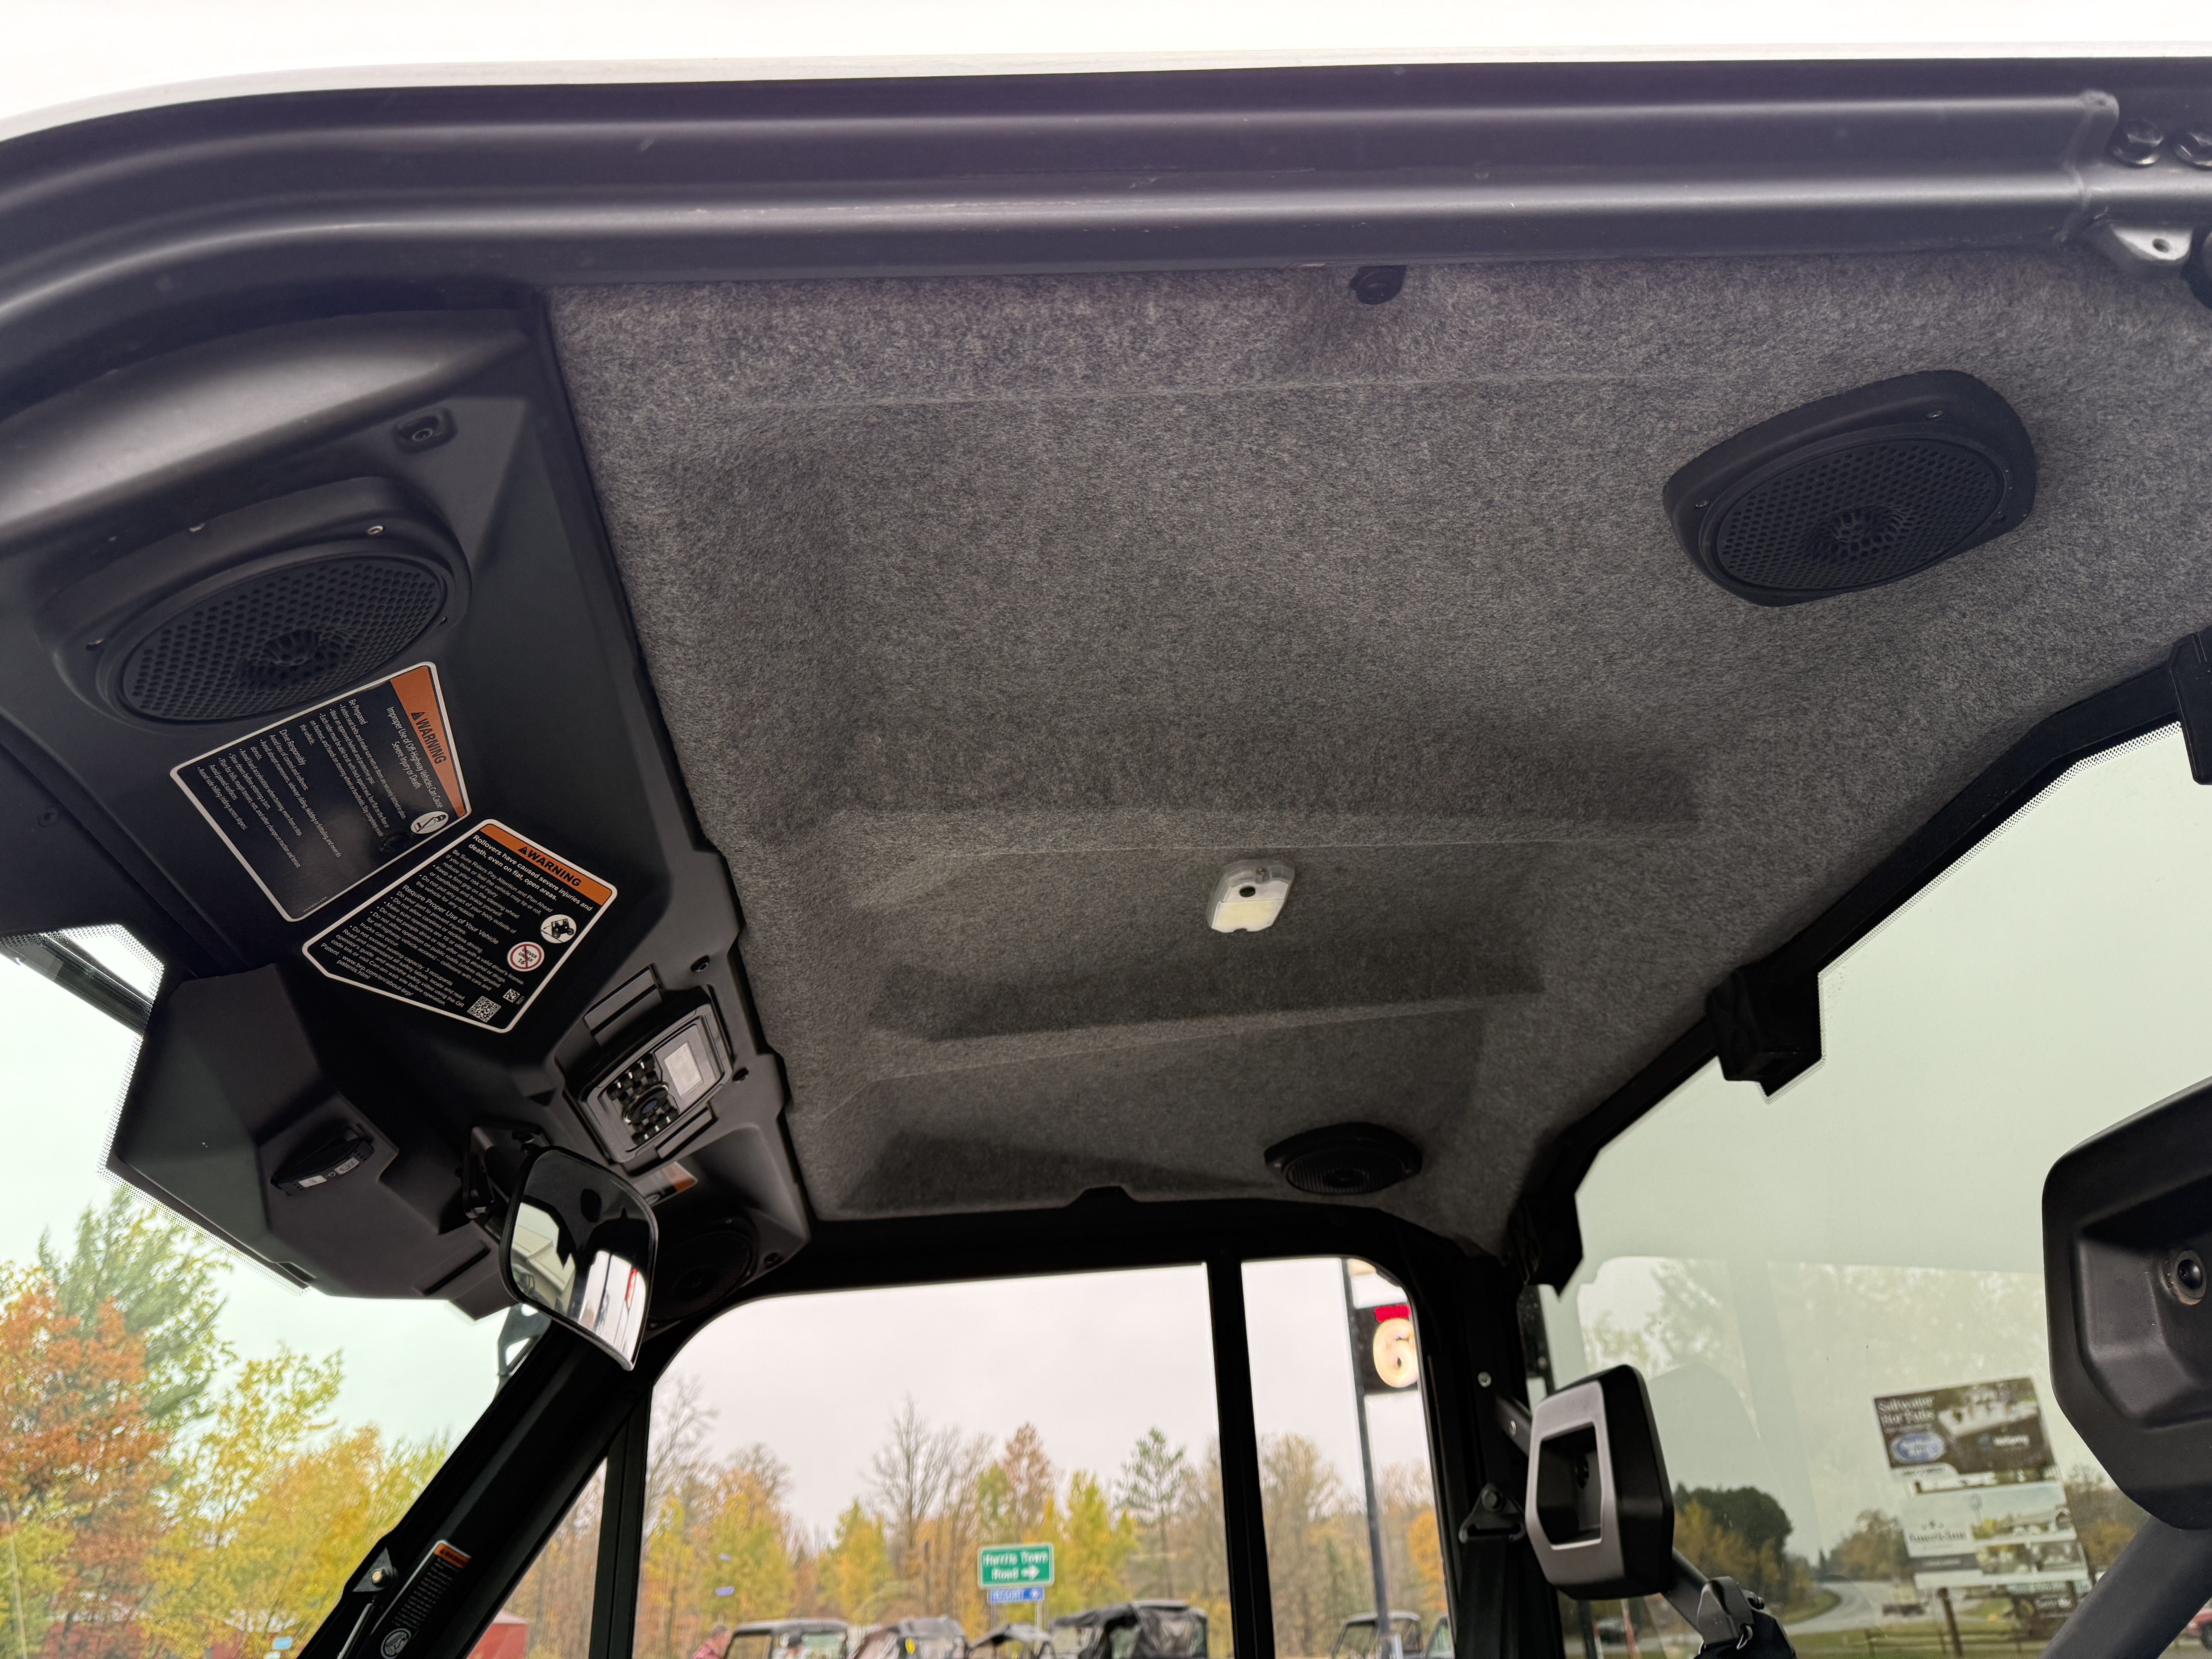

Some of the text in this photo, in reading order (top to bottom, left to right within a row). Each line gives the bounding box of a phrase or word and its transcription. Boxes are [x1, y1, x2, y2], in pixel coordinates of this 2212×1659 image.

[352, 704, 368, 725] Prepared
[386, 706, 403, 730] Improper
[398, 728, 407, 739] Use
[416, 718, 447, 764] WARNING
[279, 729, 307, 766] Drive Responsibly
[405, 743, 424, 771] Off-Highway
[391, 741, 404, 758] Severe
[399, 756, 411, 771] Injury
[409, 774, 422, 789] Death
[419, 769, 433, 788] Vehicles
[428, 787, 437, 797] Can
[432, 795, 443, 809] Cause
[472, 835, 593, 912] Rollovers have caused severe injuries and
[488, 856, 503, 867] even
[524, 878, 540, 890] open
[527, 850, 581, 886] WARNING
[519, 952, 533, 962] UNDER
[522, 947, 537, 959] DRIVER
[1373, 1318, 1419, 1388] 6
